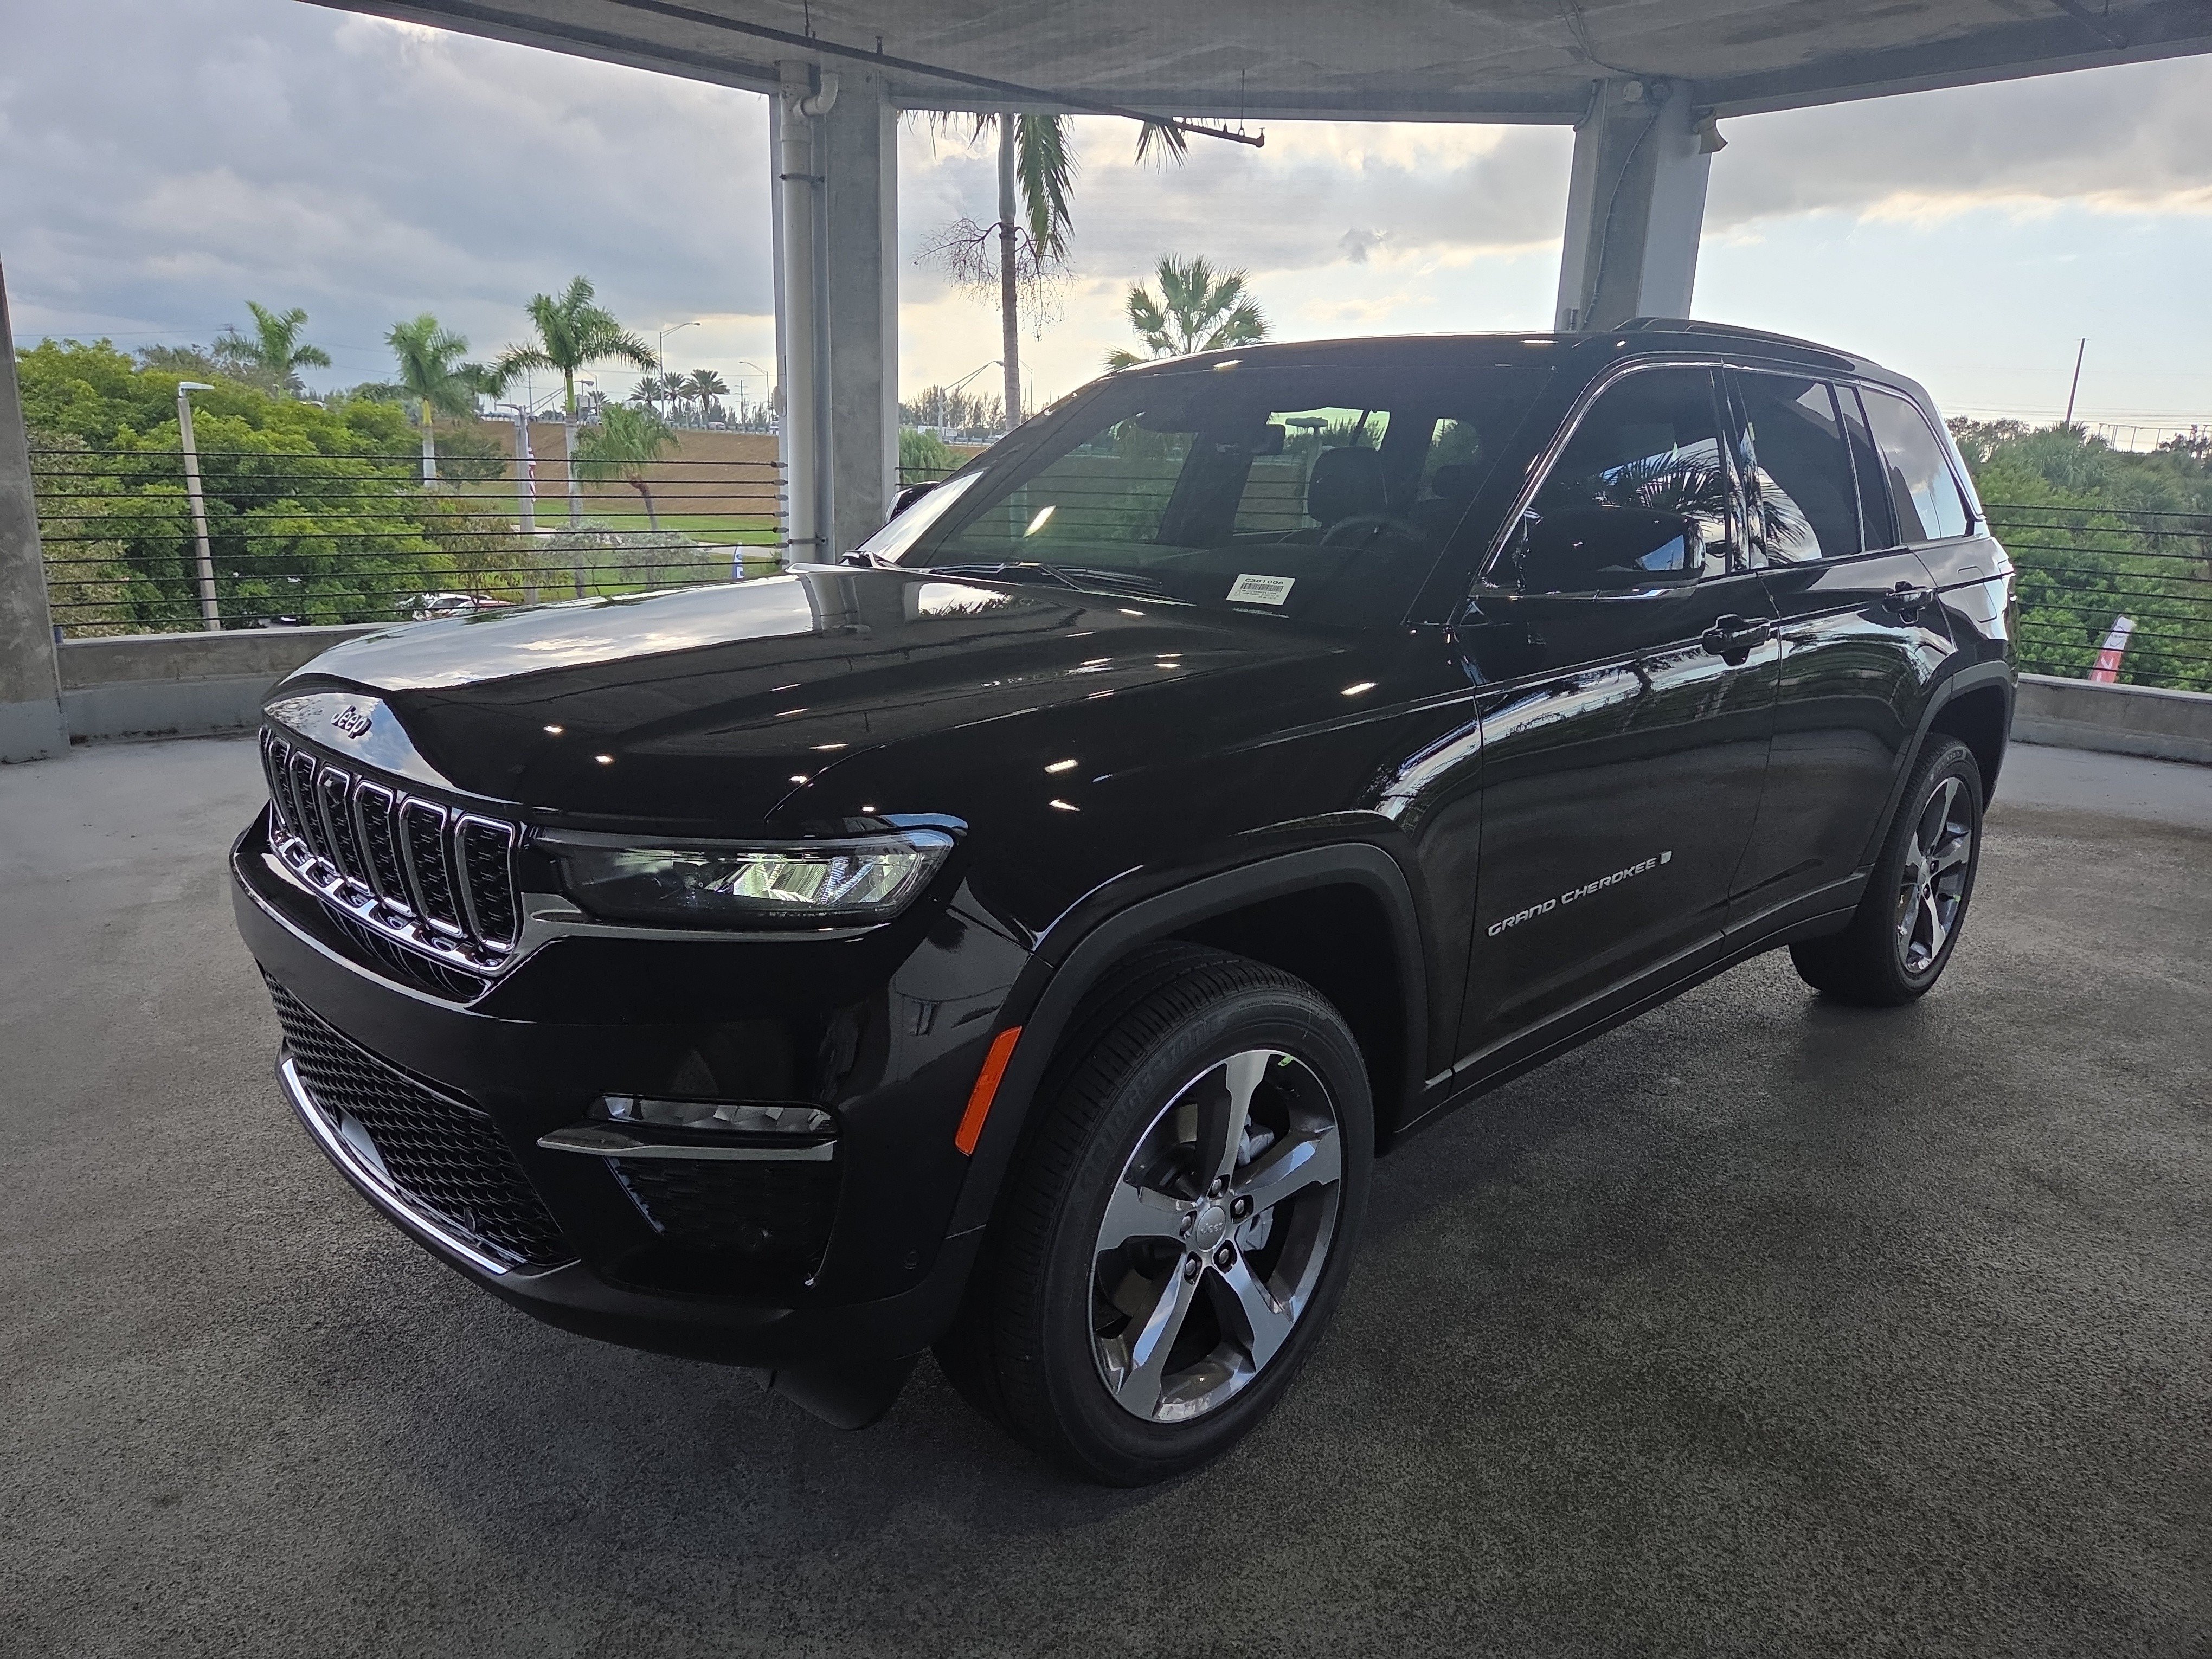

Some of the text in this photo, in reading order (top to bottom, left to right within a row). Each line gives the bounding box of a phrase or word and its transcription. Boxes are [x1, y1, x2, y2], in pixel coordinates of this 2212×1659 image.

[330, 704, 371, 738] Jeep
[1487, 857, 1657, 937] GRAND CHEROKEE
[1200, 1222, 1224, 1235] Jeep
